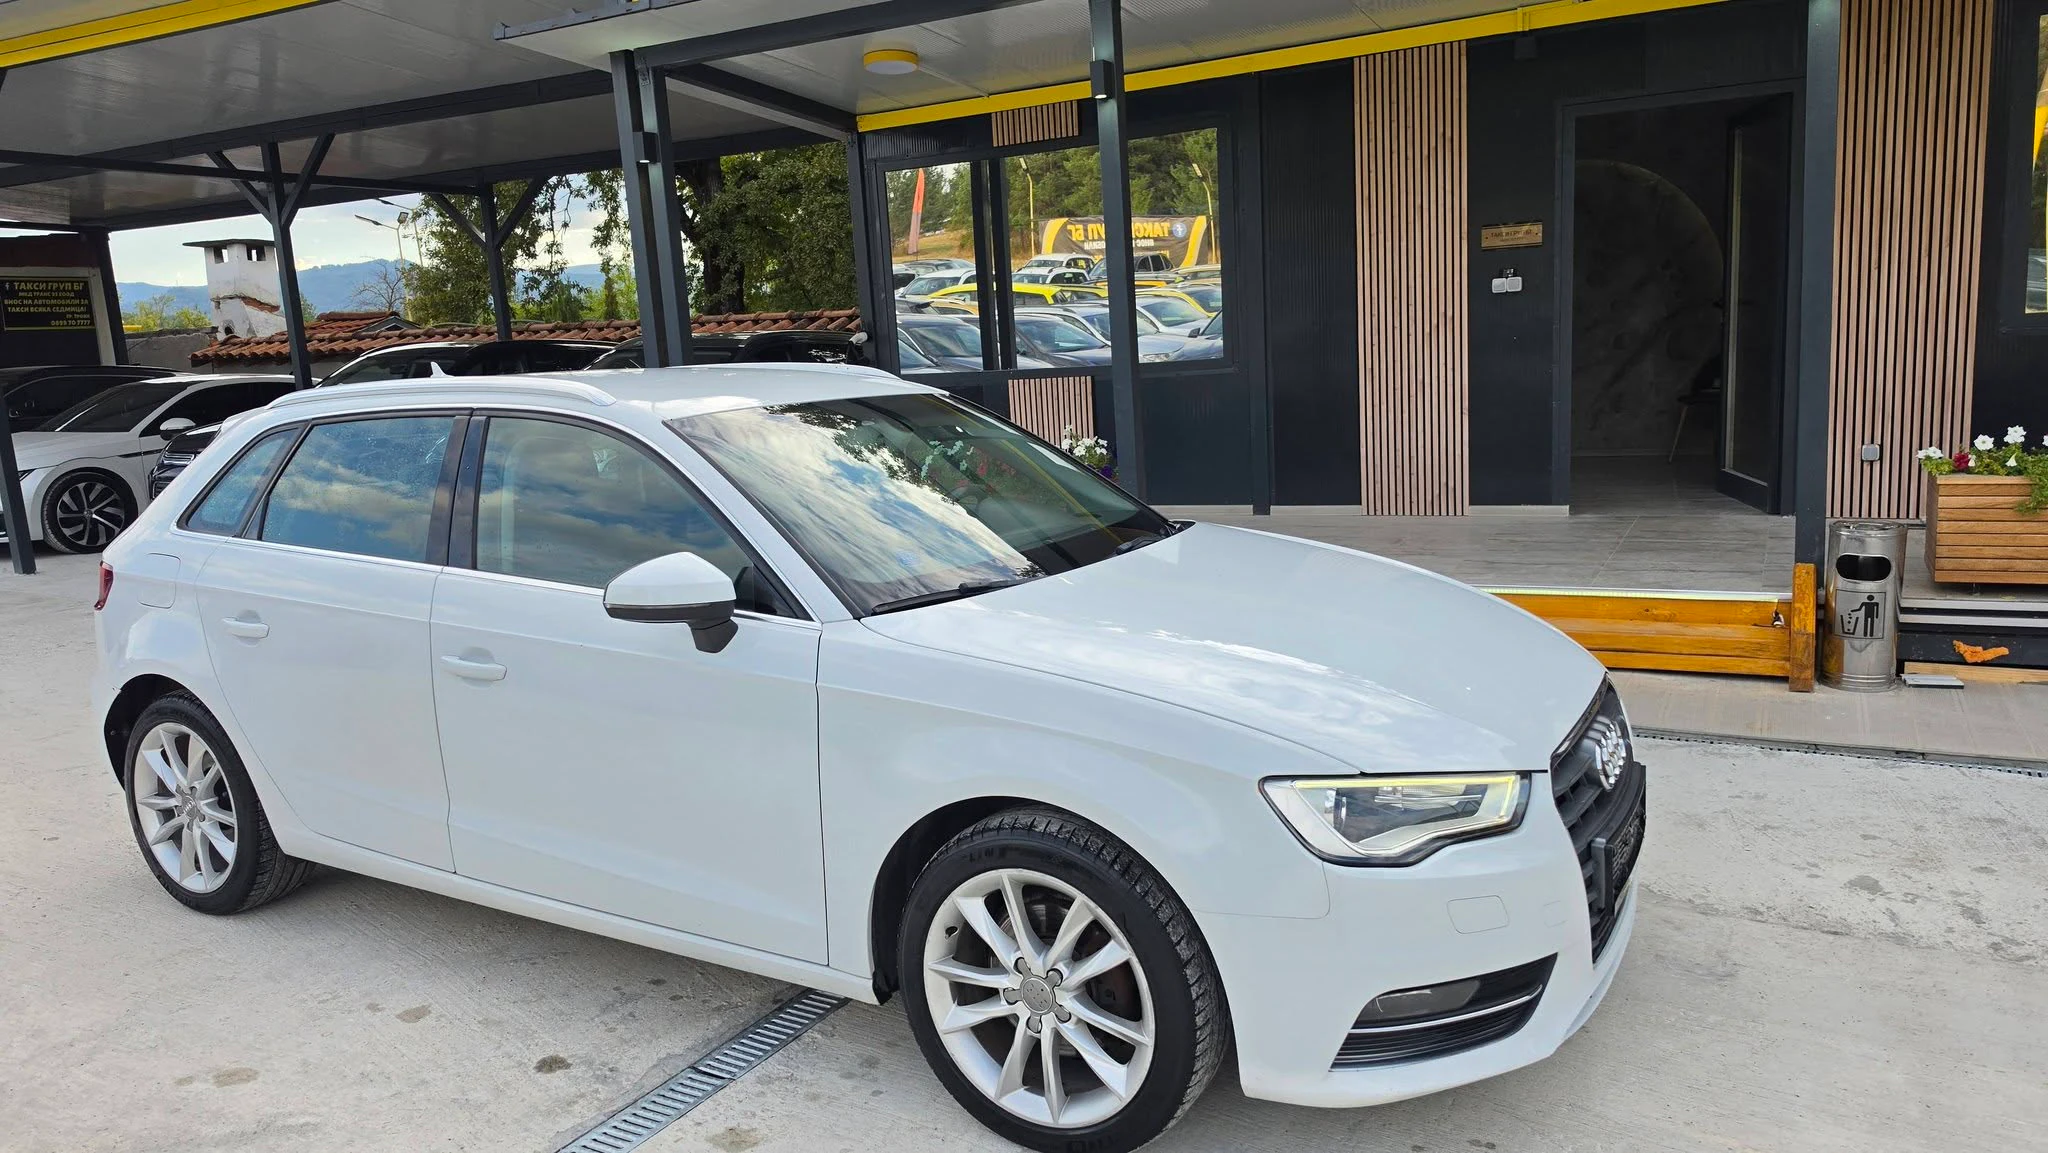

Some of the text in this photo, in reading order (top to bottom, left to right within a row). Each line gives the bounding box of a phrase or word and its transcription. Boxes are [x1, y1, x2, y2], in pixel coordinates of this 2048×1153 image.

[14, 282, 84, 290] ТАКСИ ГРУП БГ
